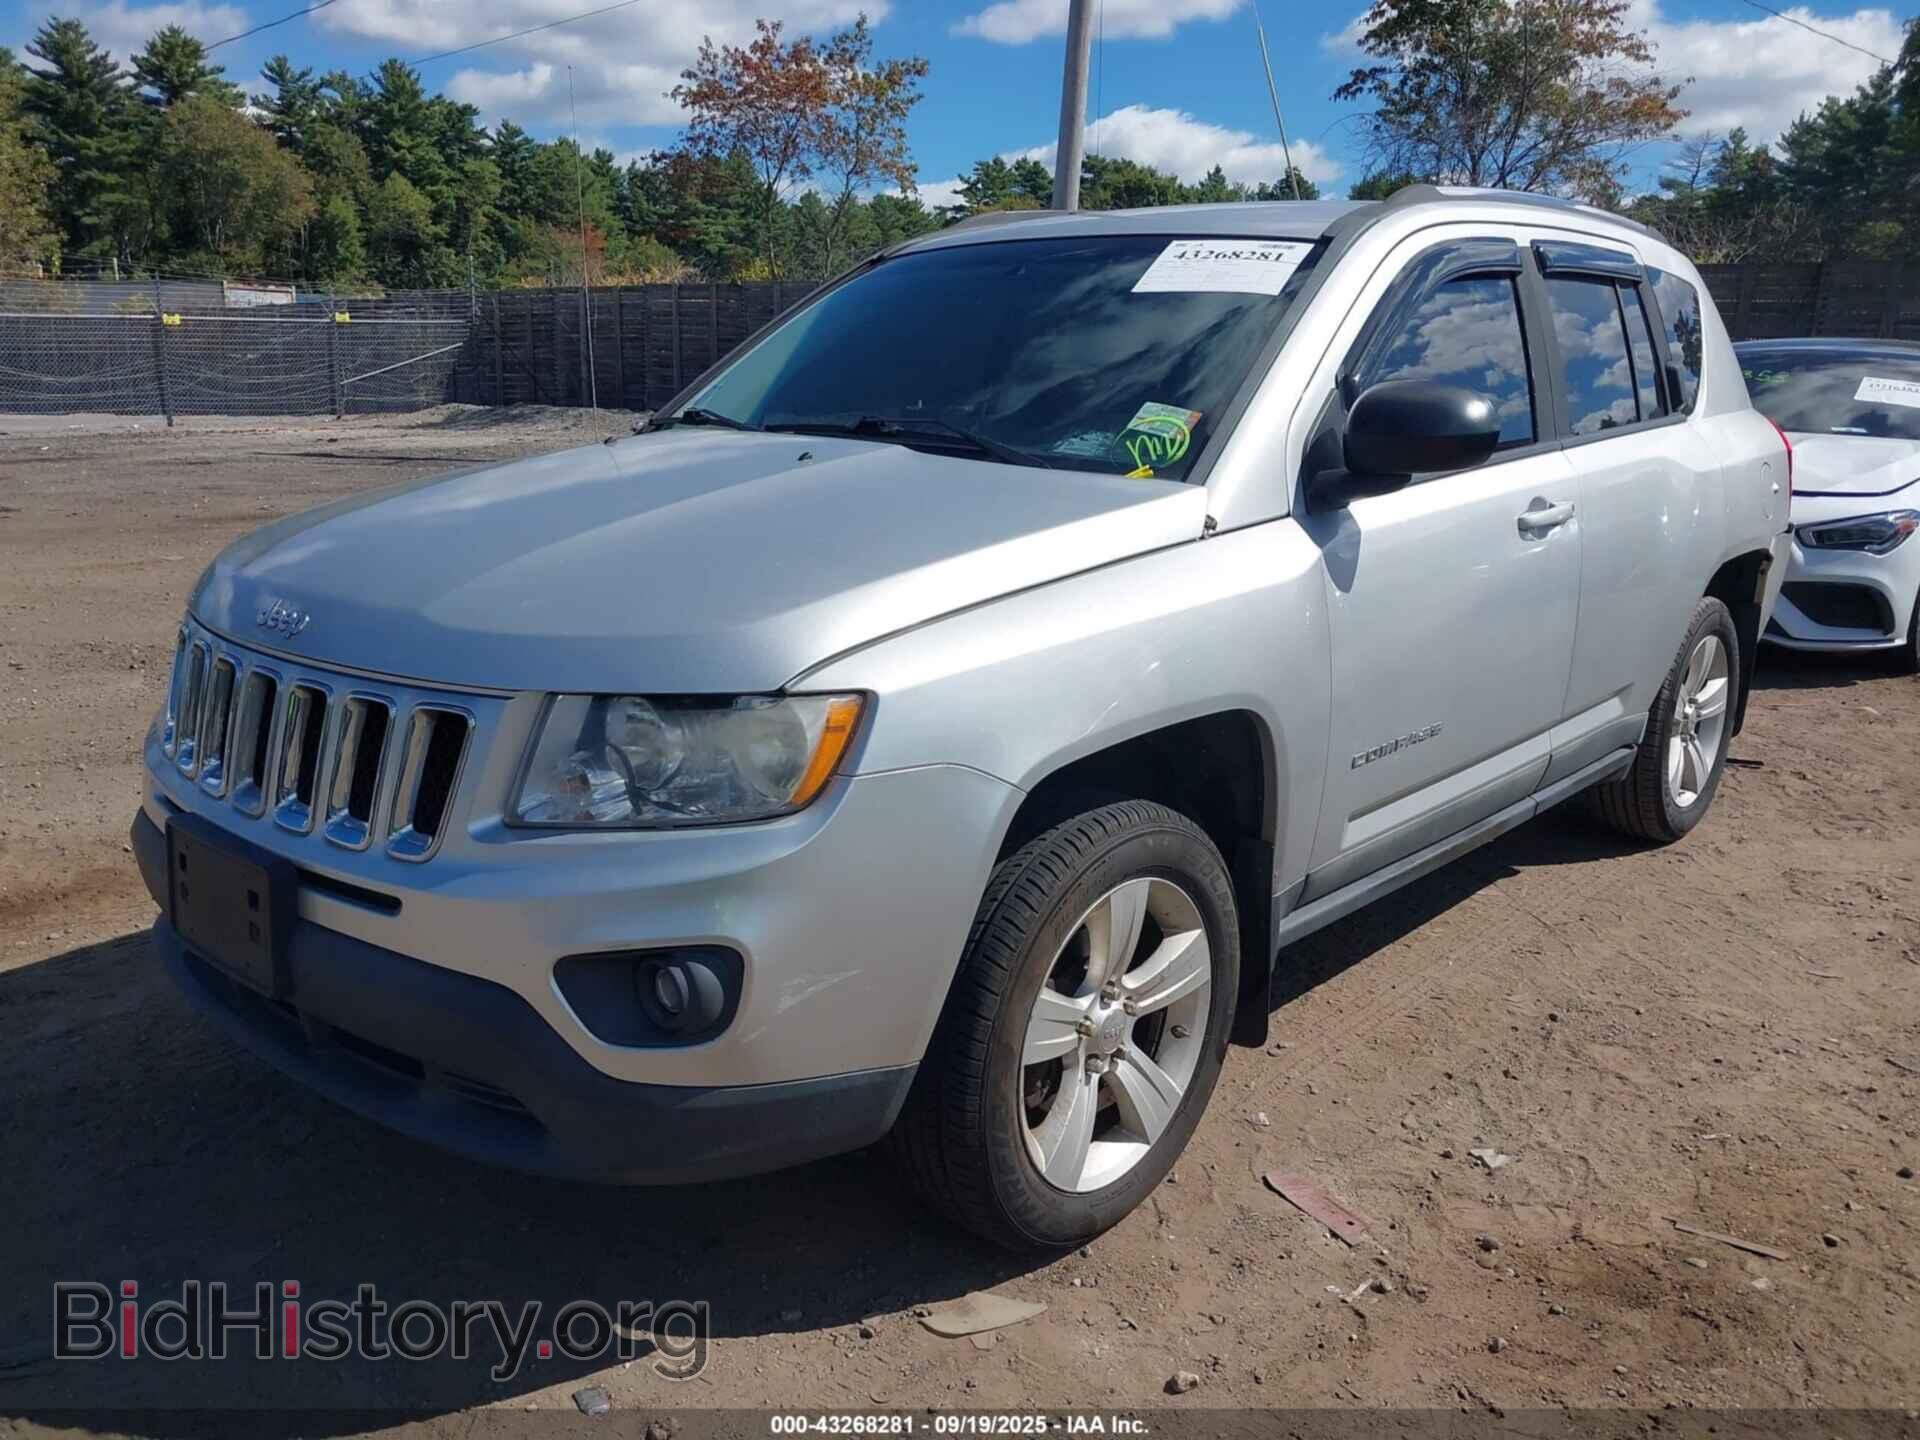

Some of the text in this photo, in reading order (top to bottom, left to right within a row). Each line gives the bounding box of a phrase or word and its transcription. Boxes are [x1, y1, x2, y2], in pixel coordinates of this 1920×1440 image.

[1172, 249, 1286, 262] 43268281
[256, 599, 310, 640] Jeep
[1351, 720, 1444, 770] COMPASS
